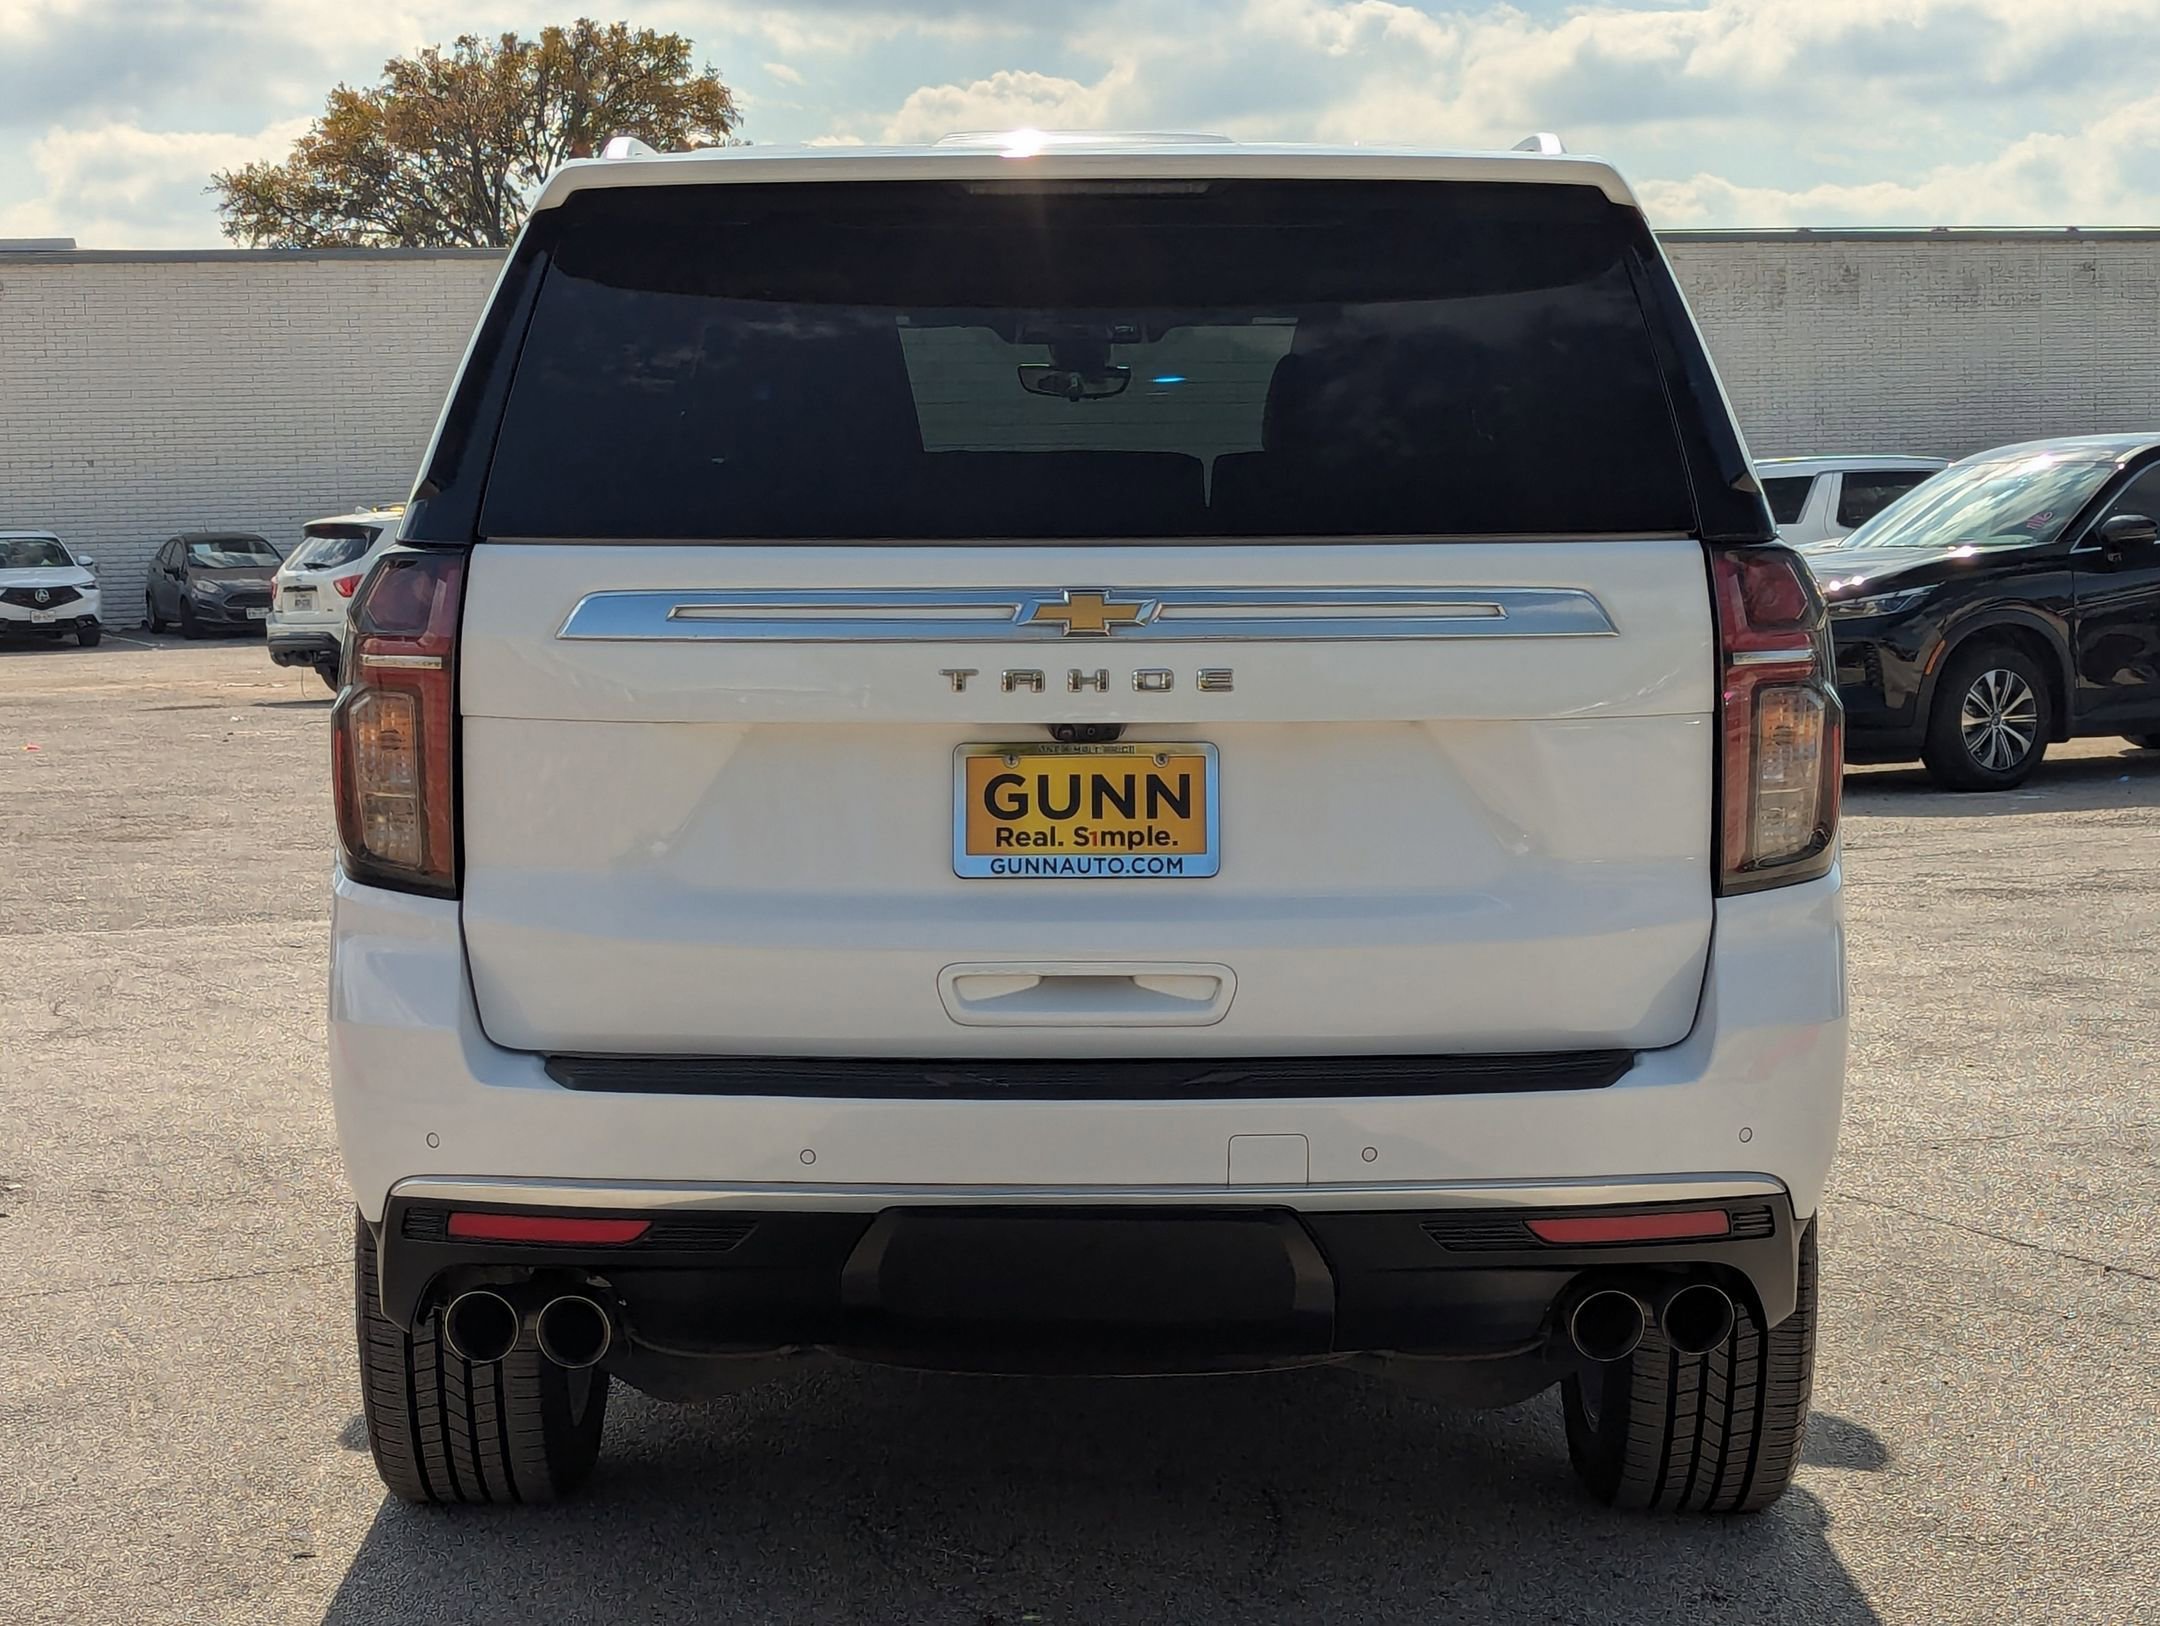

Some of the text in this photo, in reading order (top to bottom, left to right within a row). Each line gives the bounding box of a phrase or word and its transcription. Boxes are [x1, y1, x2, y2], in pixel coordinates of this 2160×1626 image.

[939, 668, 1235, 693] TAHOE
[984, 773, 1191, 820] GUNN
[996, 827, 1064, 847] Real.
[990, 858, 1183, 875] GUNNAUTO.COM
